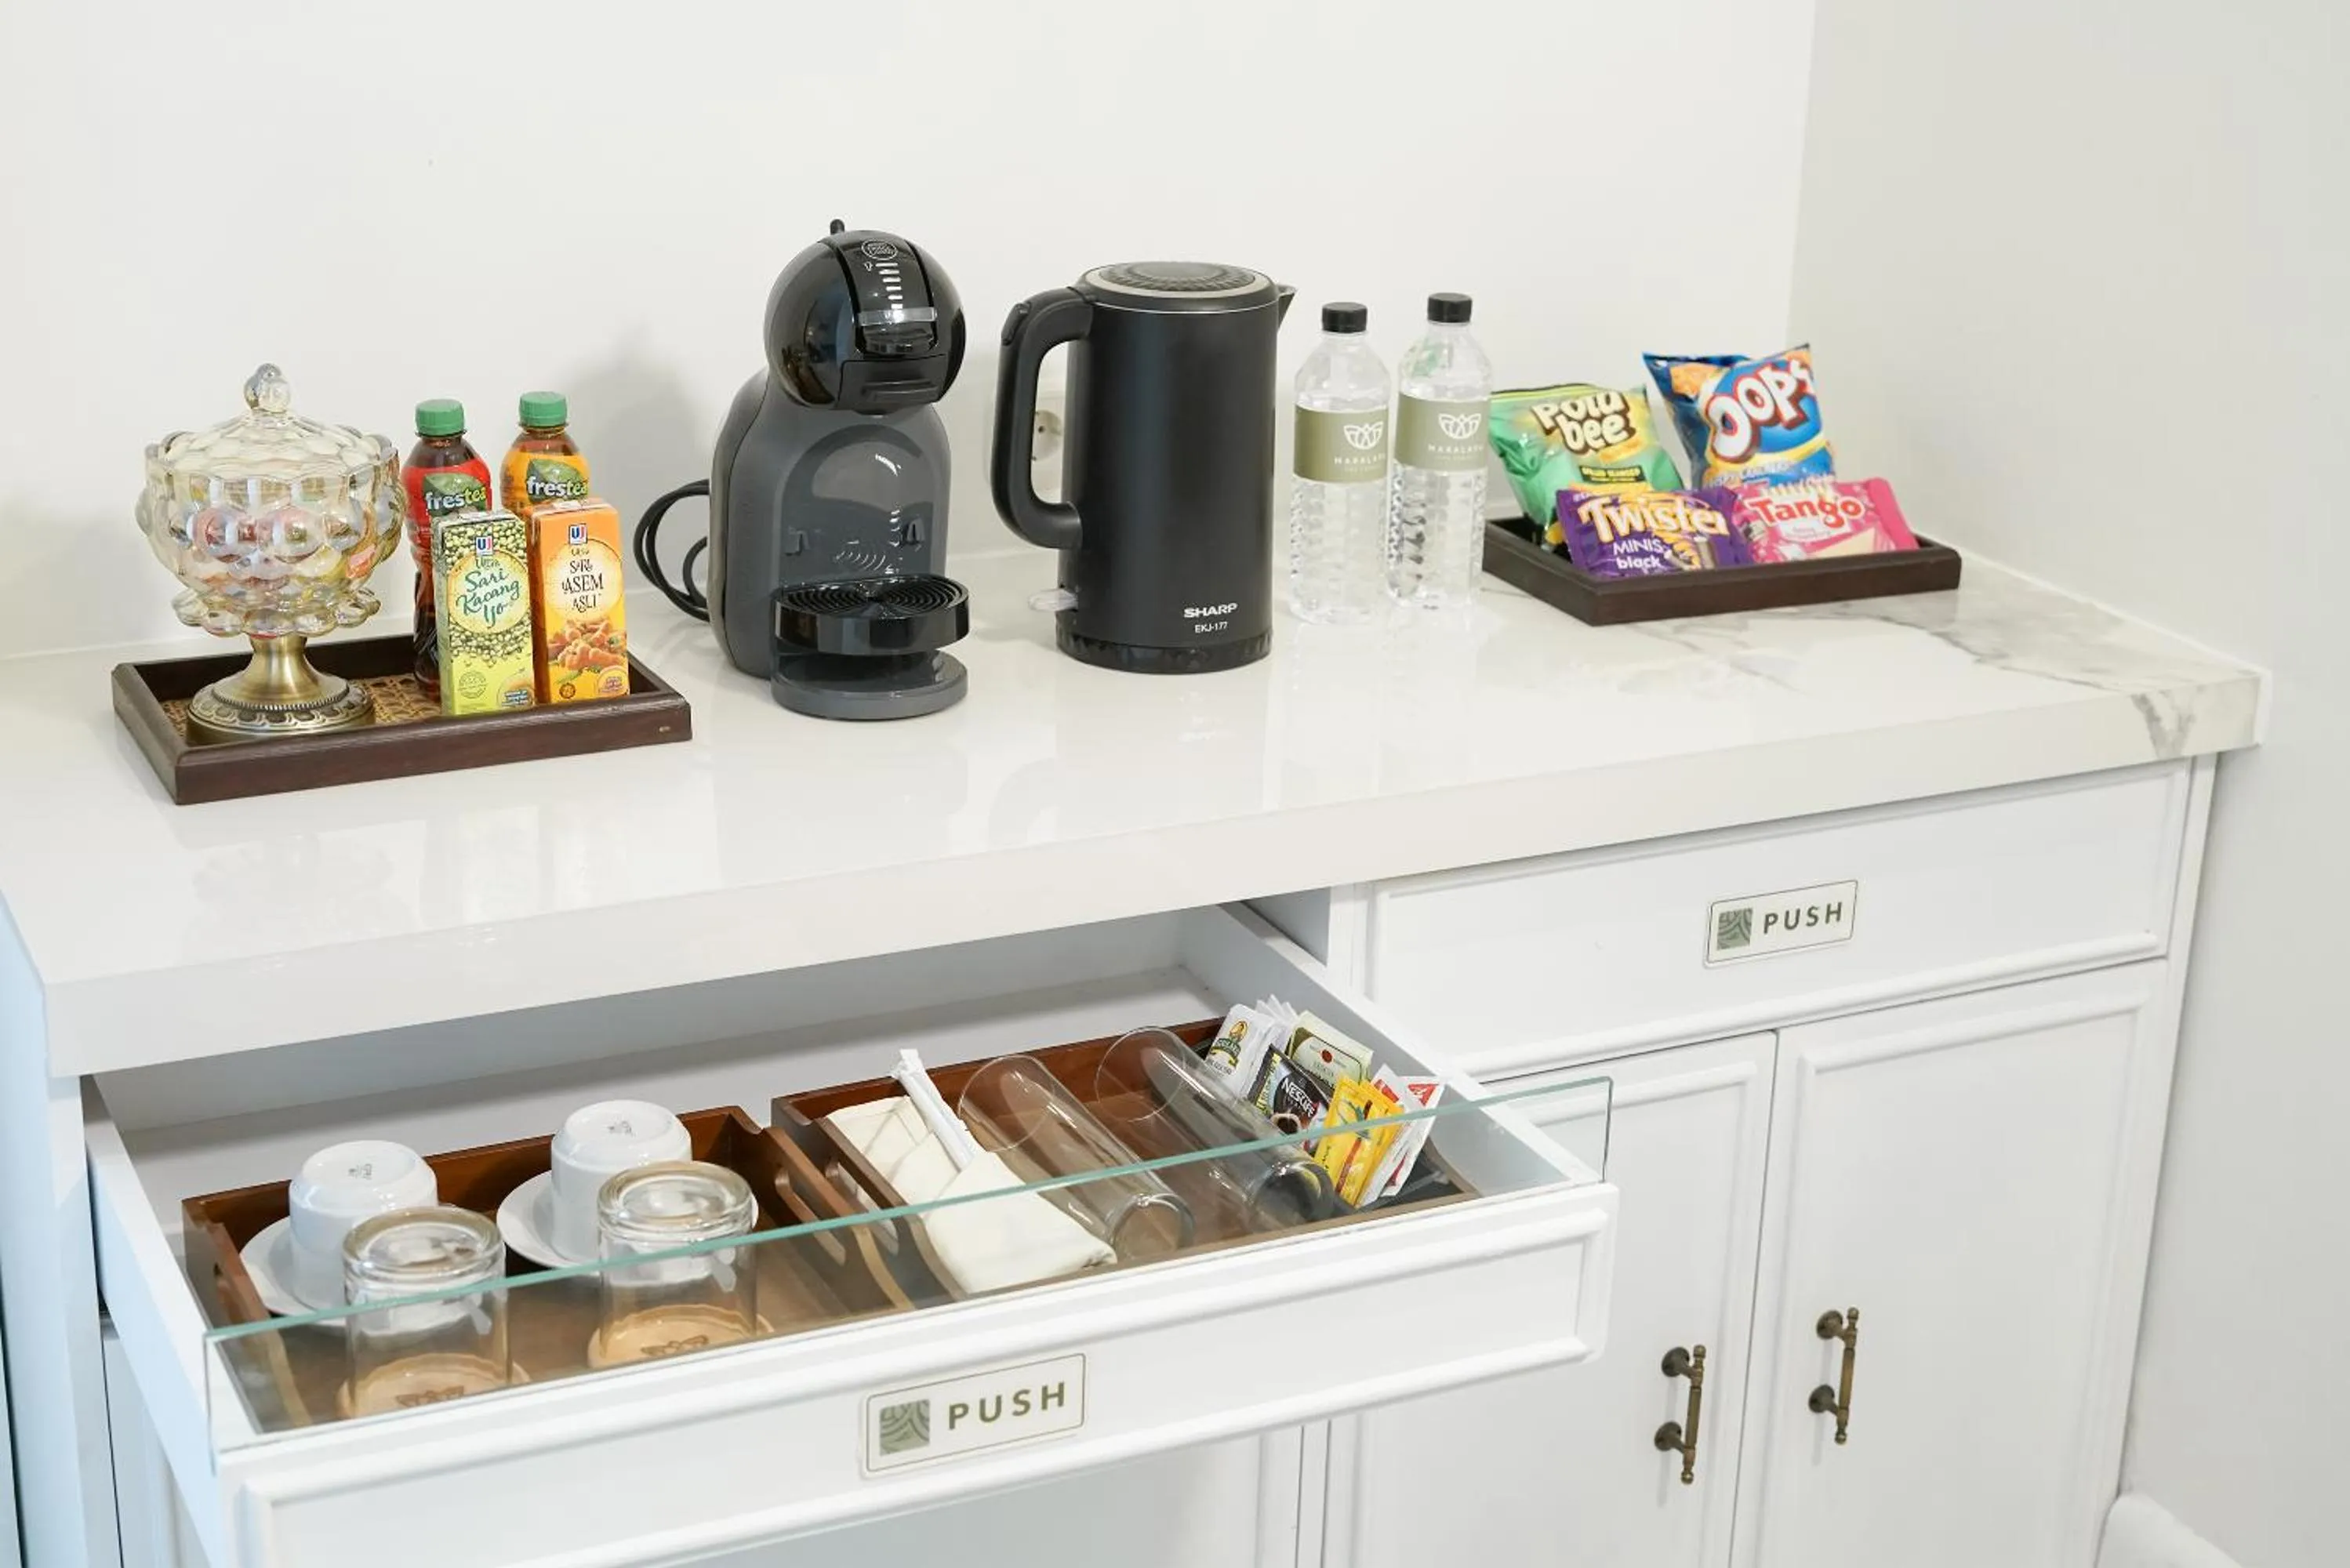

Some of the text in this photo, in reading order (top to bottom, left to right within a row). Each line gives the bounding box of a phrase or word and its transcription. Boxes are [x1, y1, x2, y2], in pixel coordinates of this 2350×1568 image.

[1746, 498, 1863, 528] Tango
[1613, 539, 1662, 555] MINIS
[1616, 555, 1662, 569] black
[1183, 602, 1238, 618] SHARP
[1763, 902, 1843, 935] PUSH
[948, 1381, 1065, 1430] PUSH
